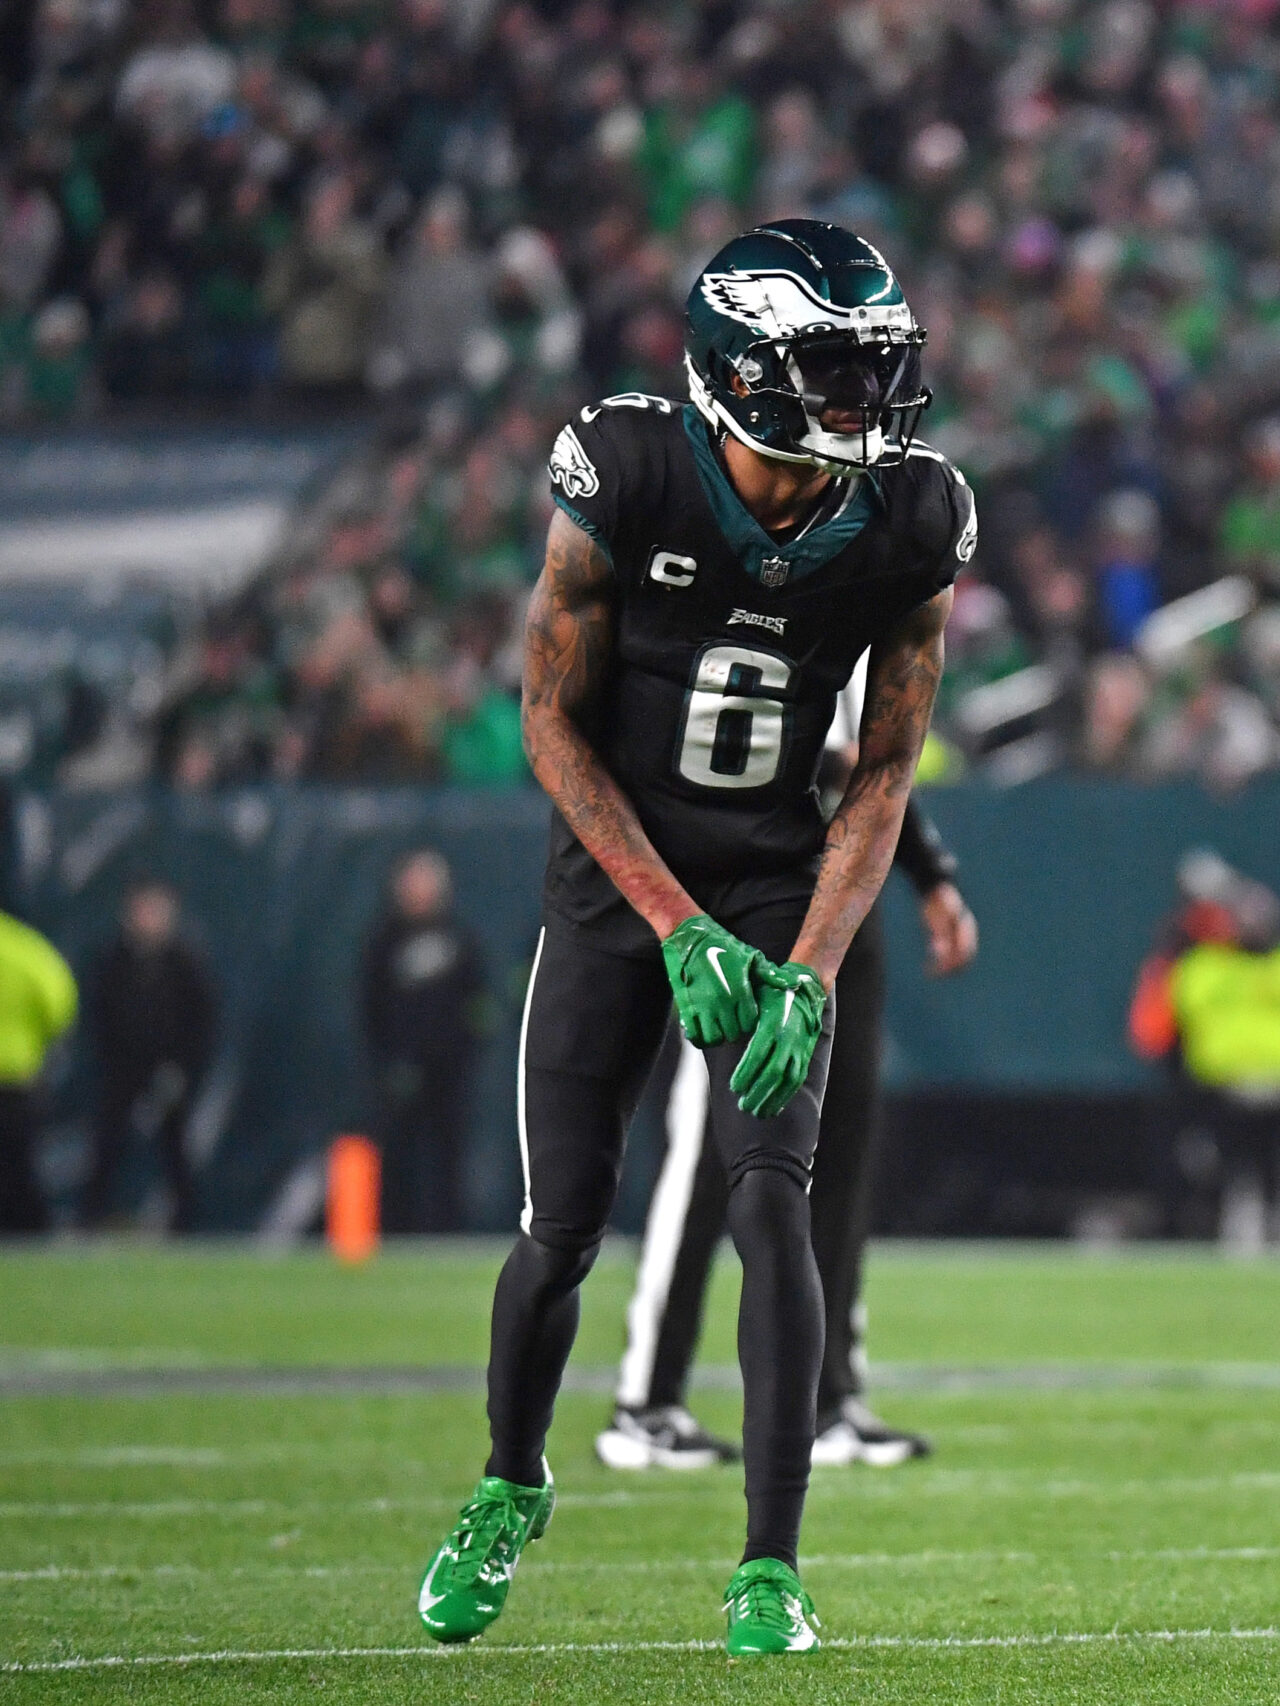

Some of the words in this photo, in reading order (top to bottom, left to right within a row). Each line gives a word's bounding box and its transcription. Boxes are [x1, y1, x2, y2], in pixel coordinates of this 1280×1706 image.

[648, 550, 698, 588] C
[726, 607, 788, 637] EAGLES
[677, 644, 794, 789] 6
